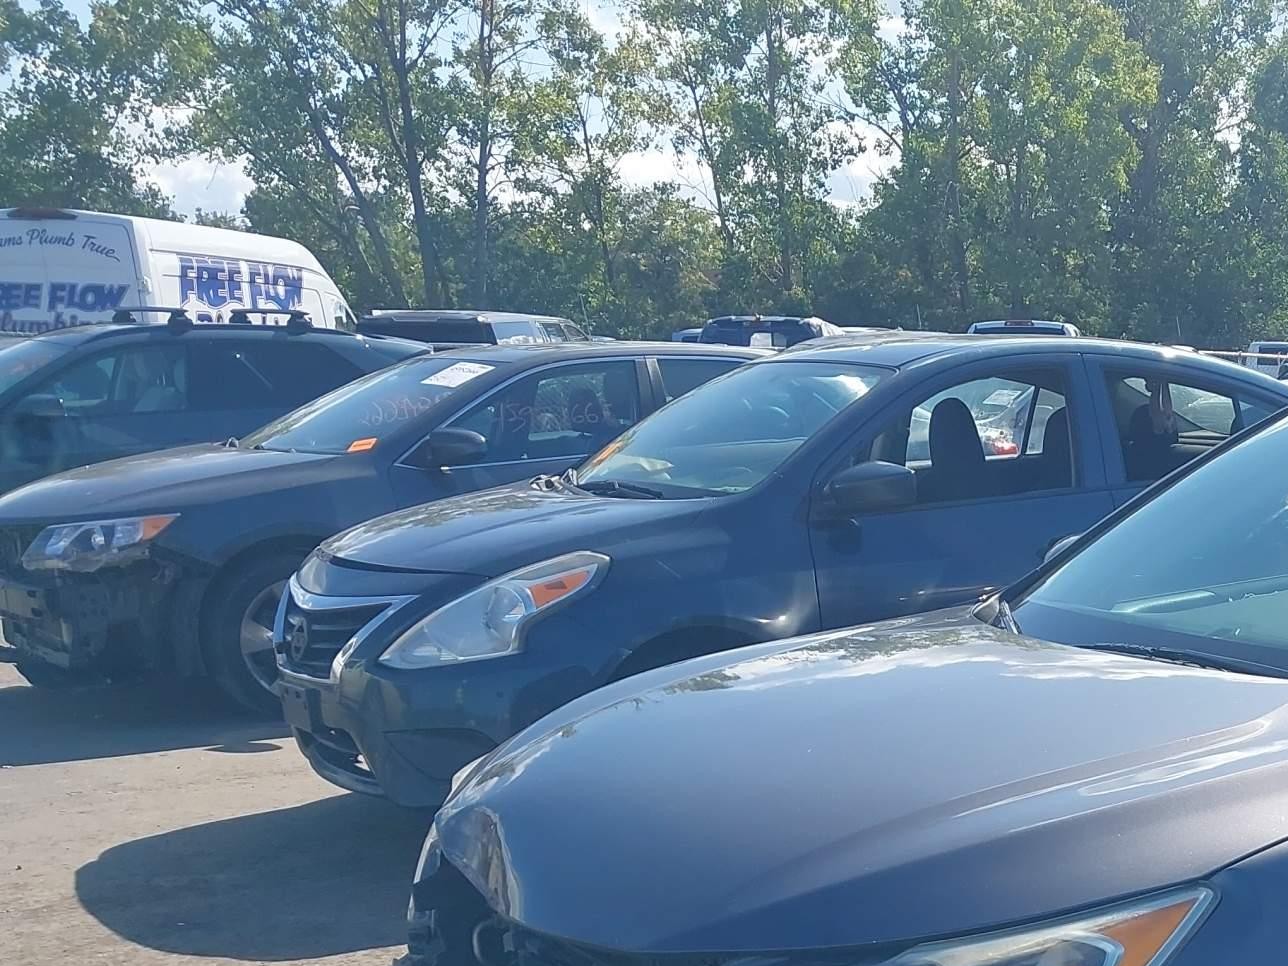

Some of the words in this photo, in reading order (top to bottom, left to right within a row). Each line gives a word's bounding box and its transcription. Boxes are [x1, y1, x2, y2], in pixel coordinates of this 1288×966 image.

[26, 228, 76, 248] Plumb
[81, 234, 121, 263] True
[47, 282, 130, 312] FLOW
[179, 255, 244, 308] FREE
[247, 261, 304, 310] FLOW
